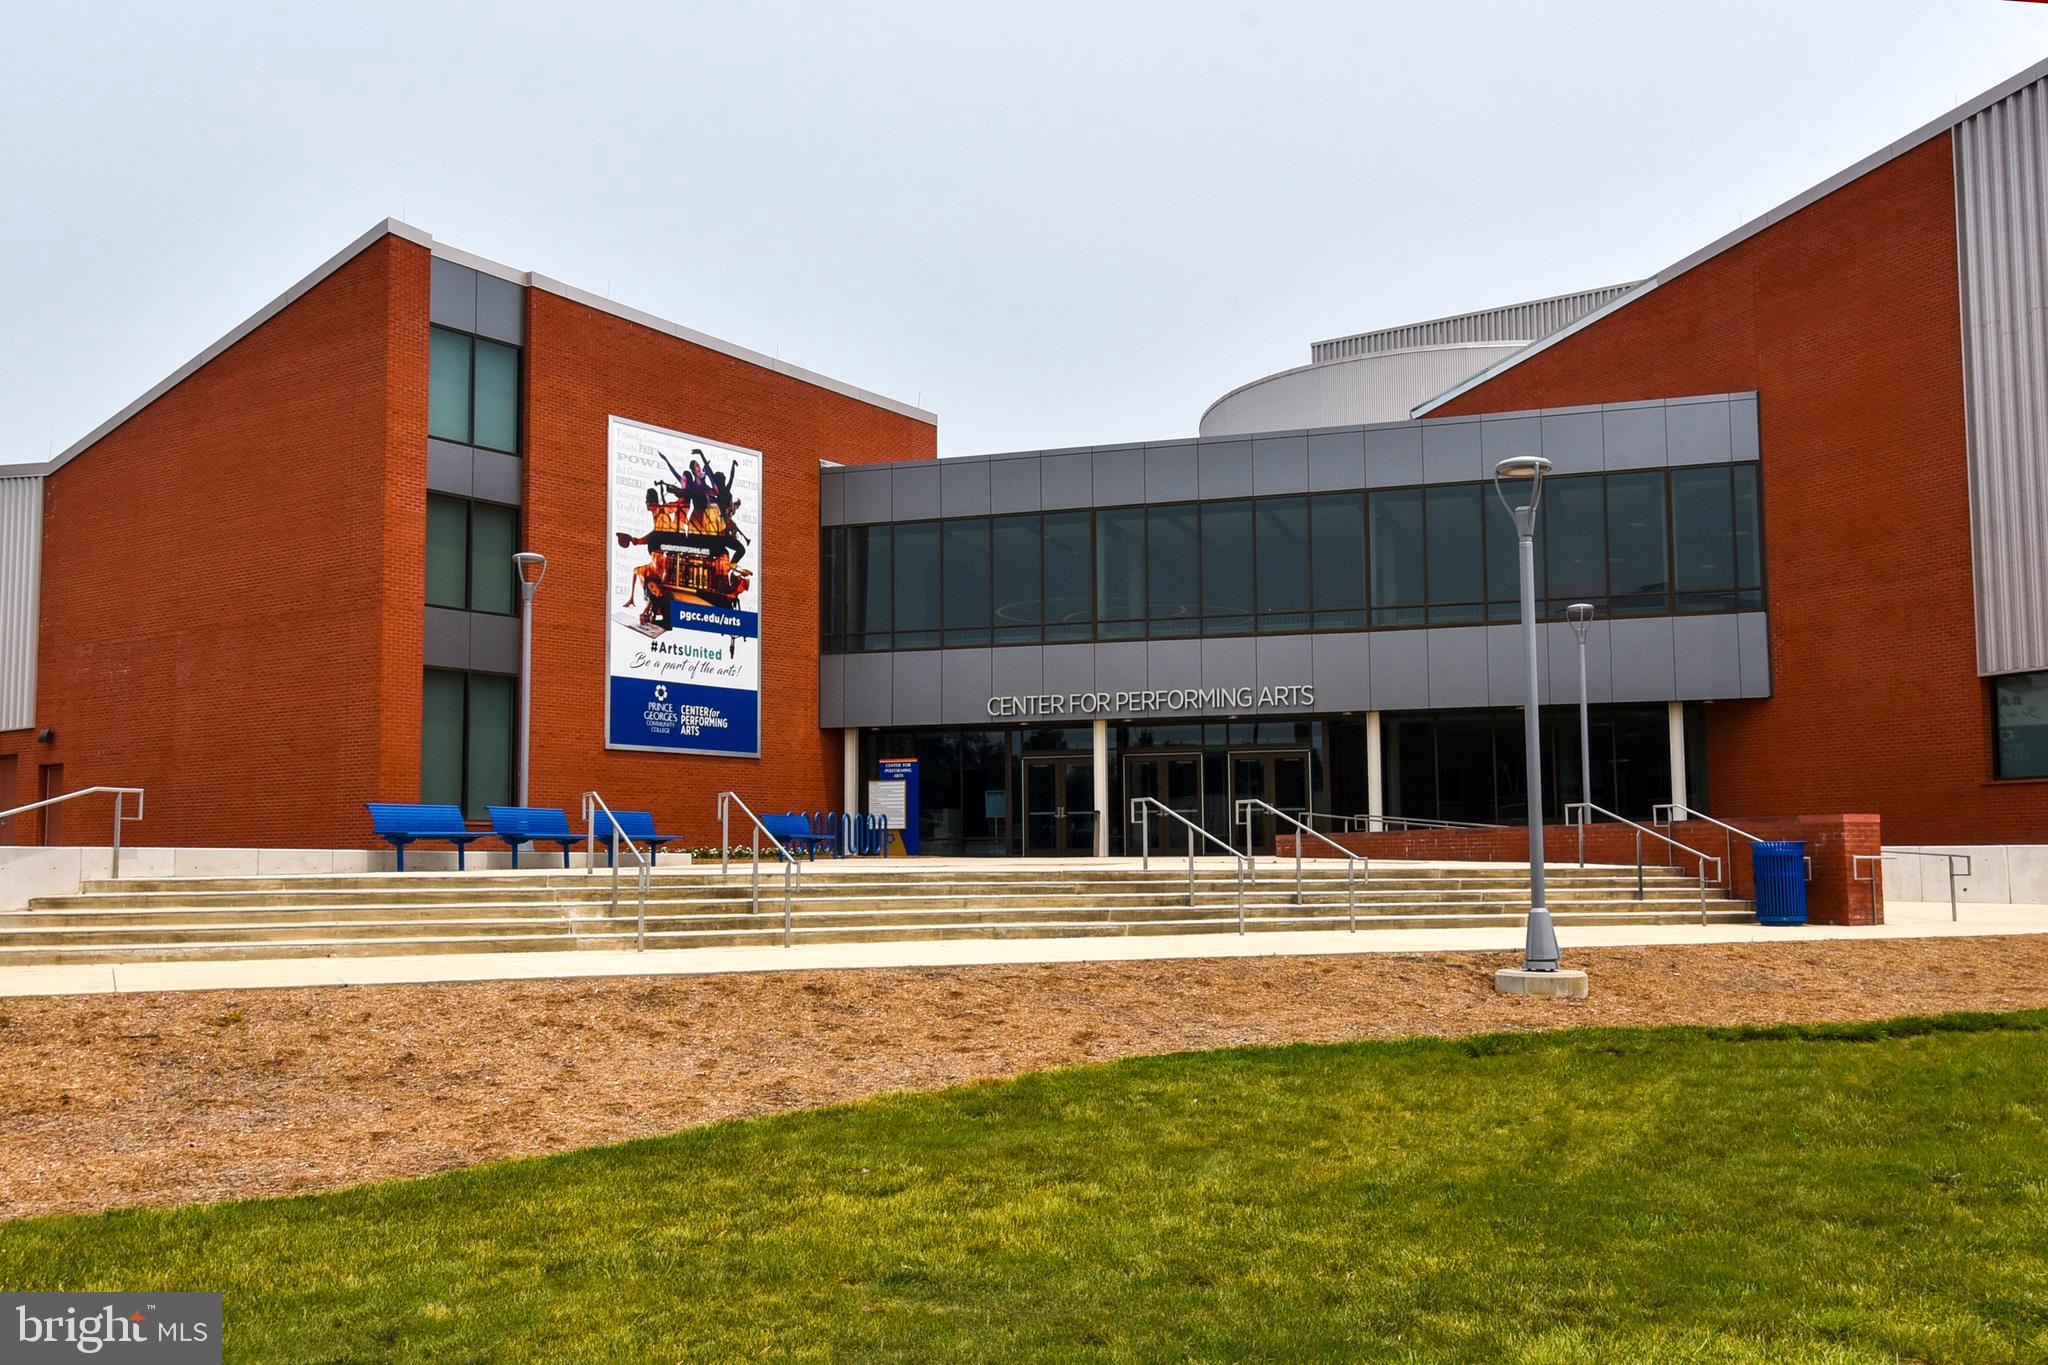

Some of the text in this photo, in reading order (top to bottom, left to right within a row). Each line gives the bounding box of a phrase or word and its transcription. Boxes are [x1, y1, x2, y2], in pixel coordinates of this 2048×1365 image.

[679, 610, 741, 627] pgcc.edu/arts
[651, 640, 722, 661] #ArtsUnited
[630, 651, 651, 669] Be
[661, 658, 688, 676] part
[688, 660, 701, 679] of
[700, 661, 715, 673] the
[716, 665, 742, 677] arts!
[987, 684, 1315, 717] CENTER FOR PERFORMING ARTS
[648, 702, 673, 713] PRINCE
[680, 705, 720, 719] CENTER for
[643, 711, 678, 722] GEORGE'S
[680, 715, 728, 728] PERFORMING
[646, 720, 675, 728] COMMUNITY
[680, 726, 700, 736] ARTS
